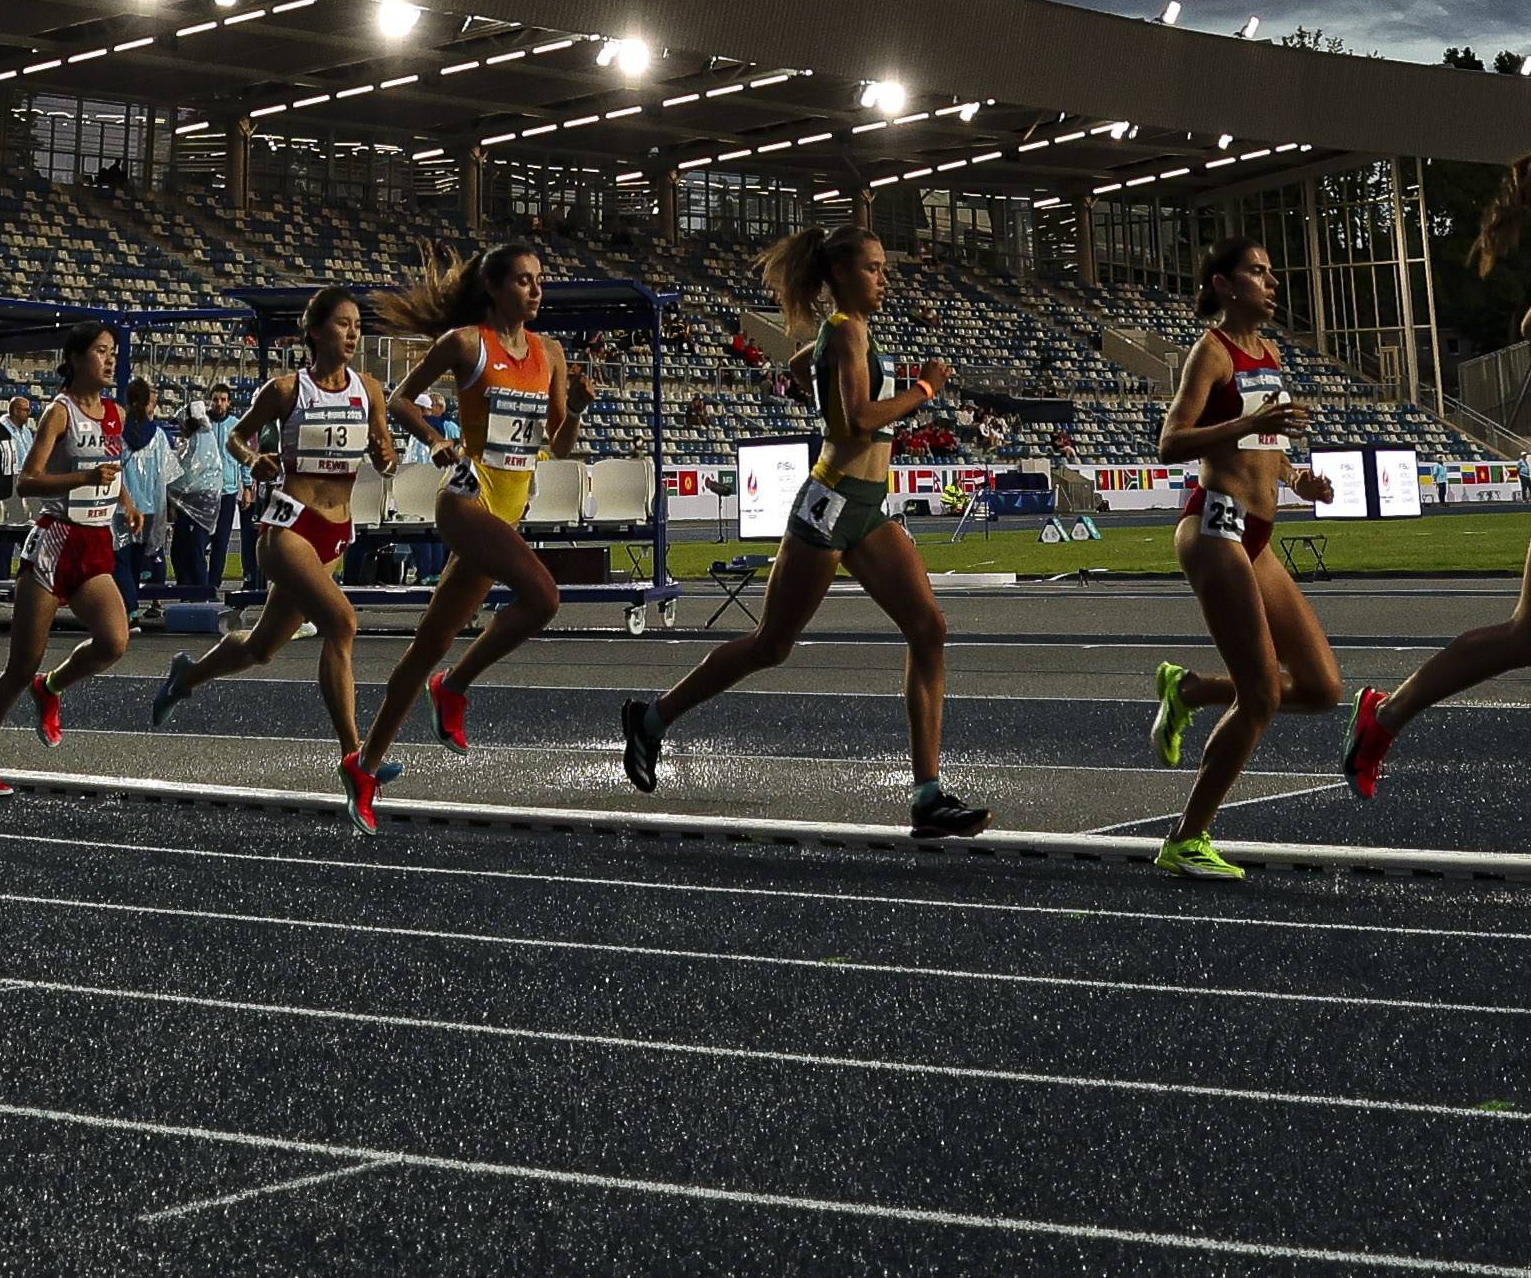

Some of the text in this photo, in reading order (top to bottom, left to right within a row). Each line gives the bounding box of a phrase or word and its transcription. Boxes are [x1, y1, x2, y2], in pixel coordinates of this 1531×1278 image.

[77, 435, 115, 448] JAPA
[324, 426, 348, 447] 13
[510, 419, 534, 443] 24
[272, 499, 294, 522] 13
[810, 497, 831, 520] 4
[1208, 502, 1237, 531] 23
